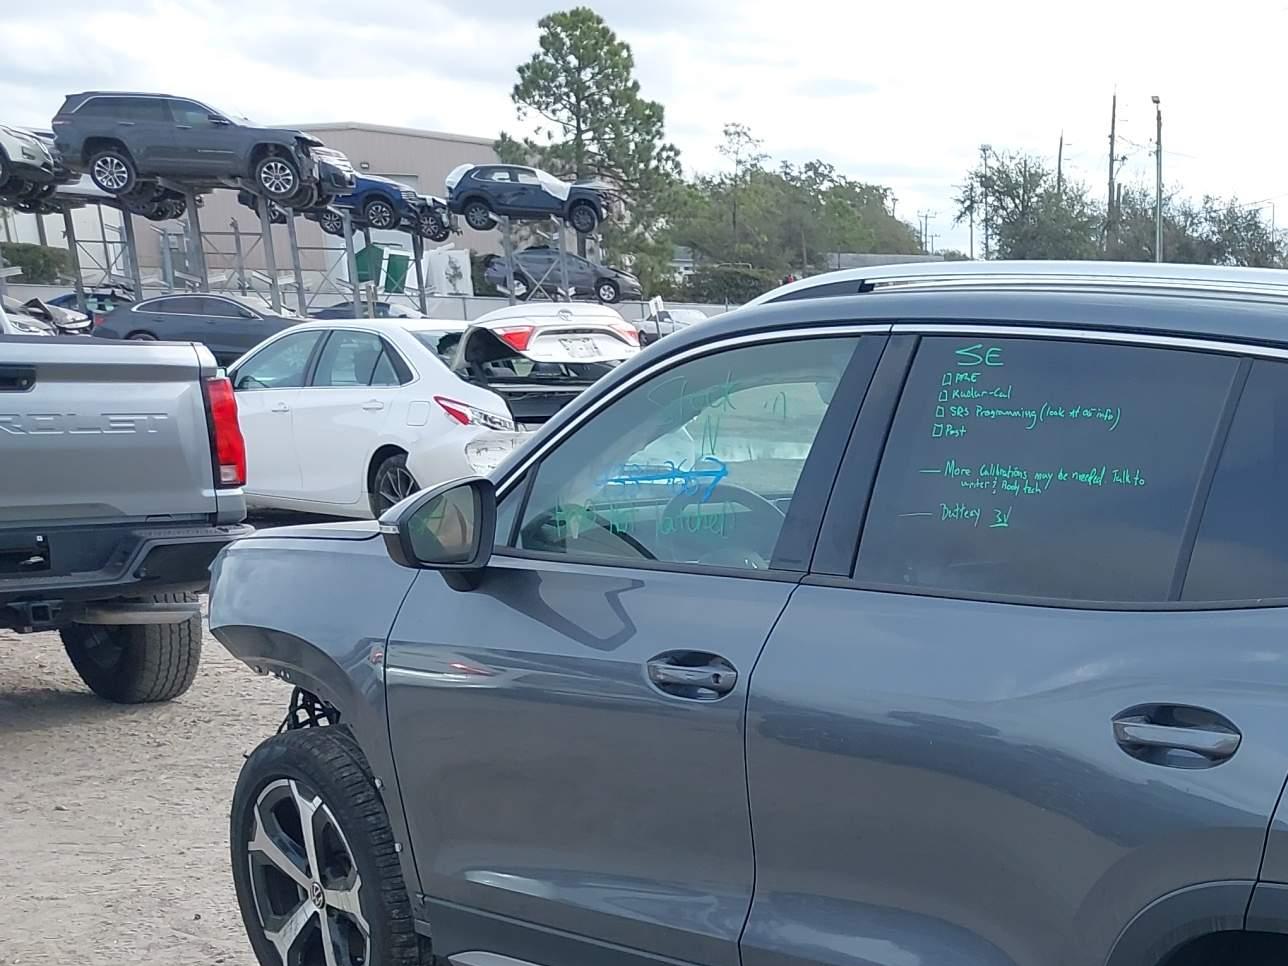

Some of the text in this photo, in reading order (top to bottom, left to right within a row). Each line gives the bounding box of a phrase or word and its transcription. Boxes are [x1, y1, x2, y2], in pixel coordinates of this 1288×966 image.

[955, 344, 1004, 366] SE
[949, 406, 970, 417] SRS
[975, 404, 1037, 430] Programming
[945, 423, 967, 437] Post
[944, 460, 972, 478] More
[1034, 472, 1054, 490] may
[1057, 468, 1068, 481] be
[1134, 469, 1145, 486] to
[939, 503, 981, 528] Battery
